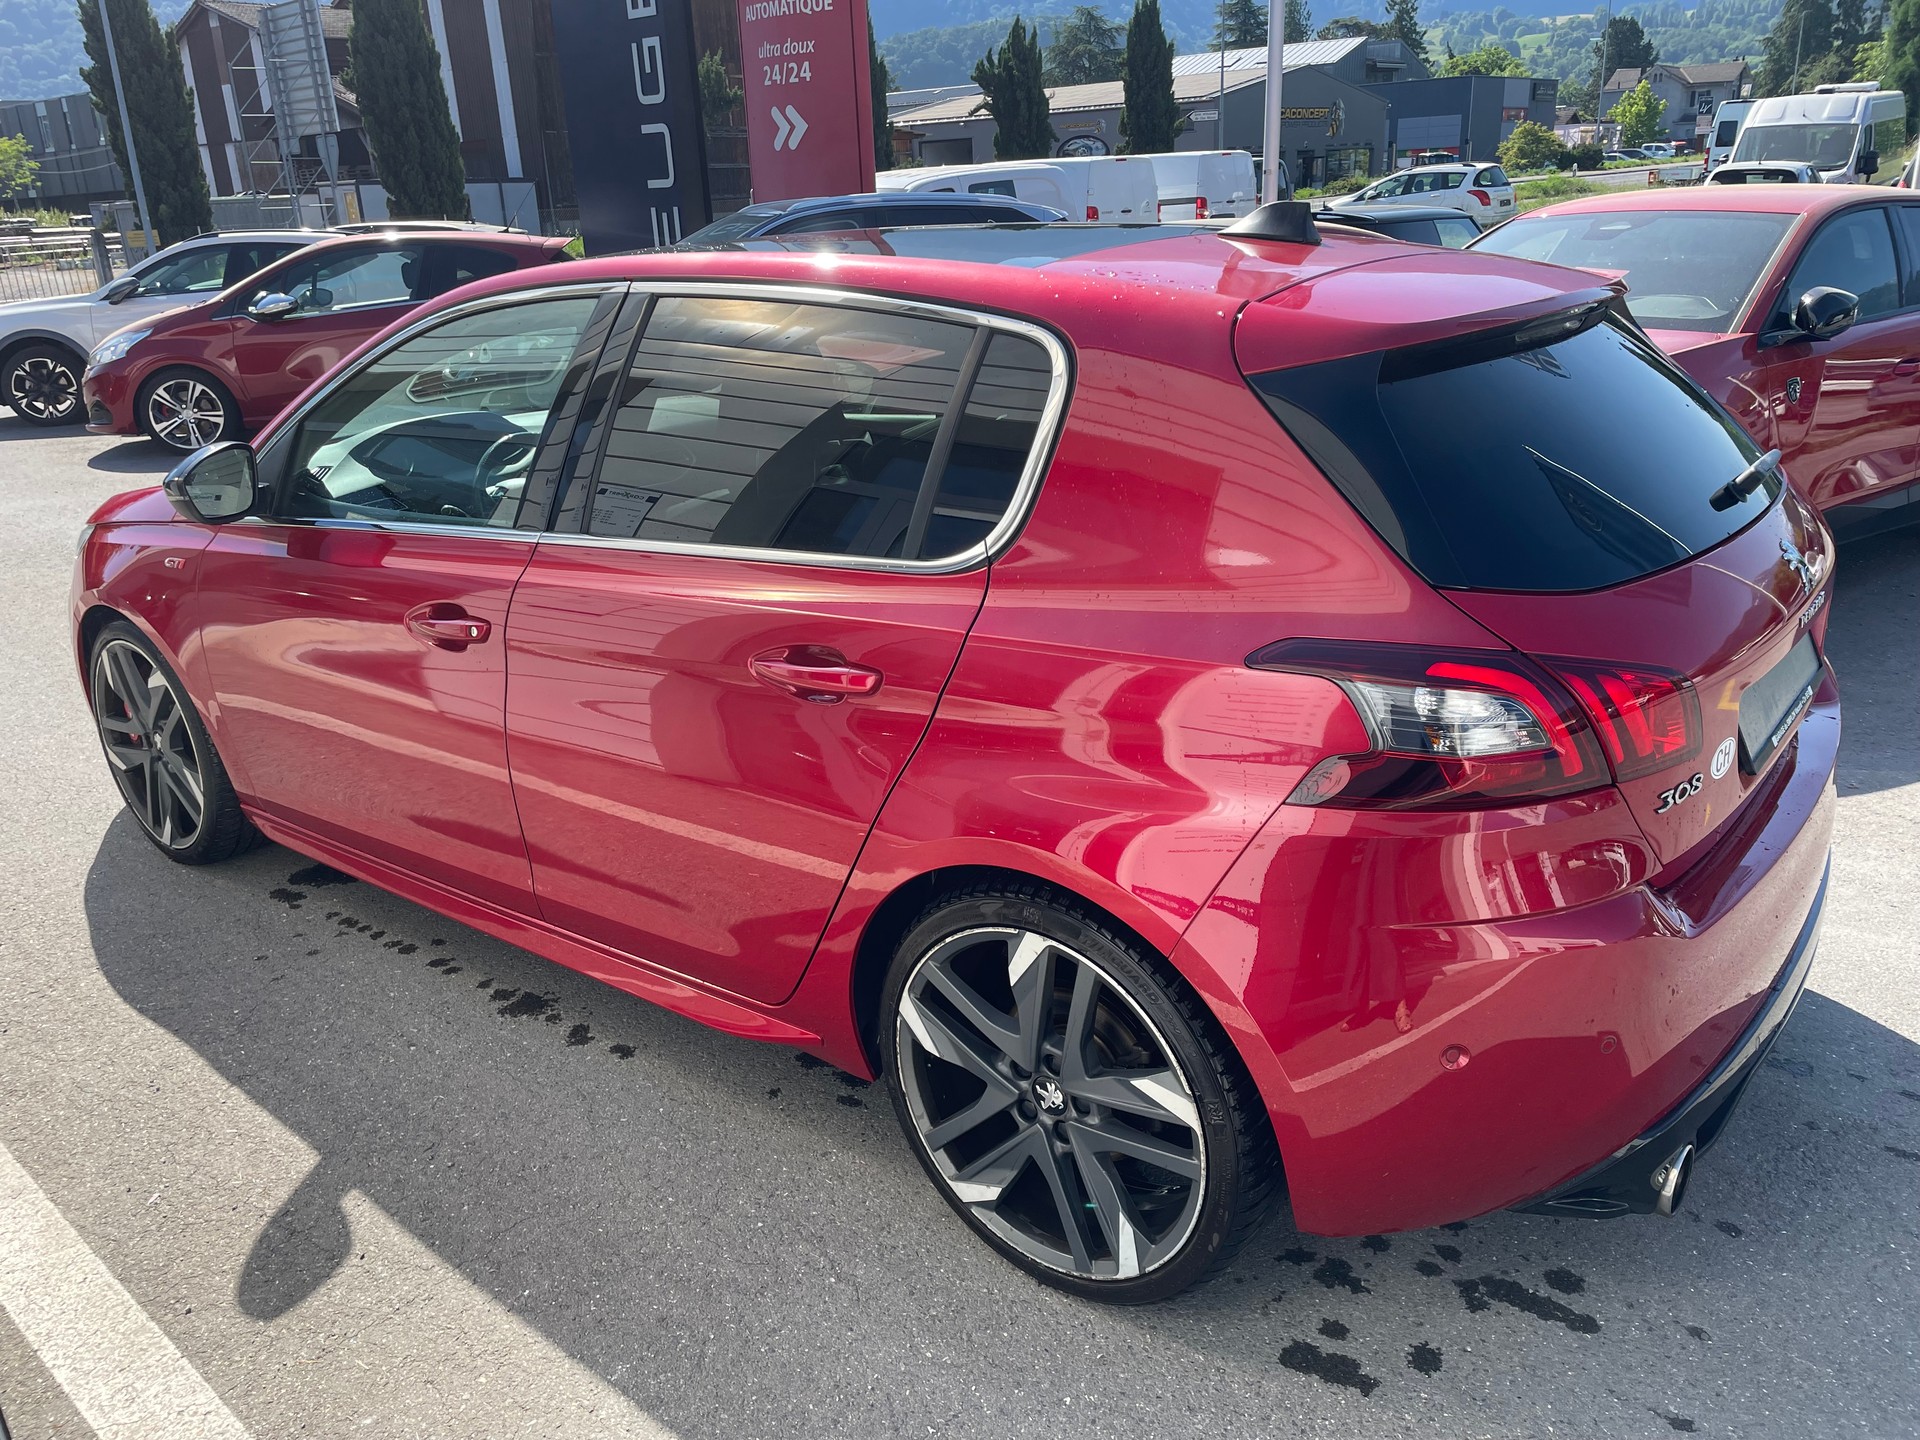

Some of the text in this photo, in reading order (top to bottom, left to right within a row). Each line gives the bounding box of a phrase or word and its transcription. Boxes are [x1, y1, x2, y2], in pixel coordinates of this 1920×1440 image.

[745, 0, 834, 22] AUTOMATIQUE
[758, 37, 815, 59] ultra doux
[763, 61, 812, 86] 24/24
[1715, 741, 1732, 773] CH
[1655, 772, 1704, 814] 308
